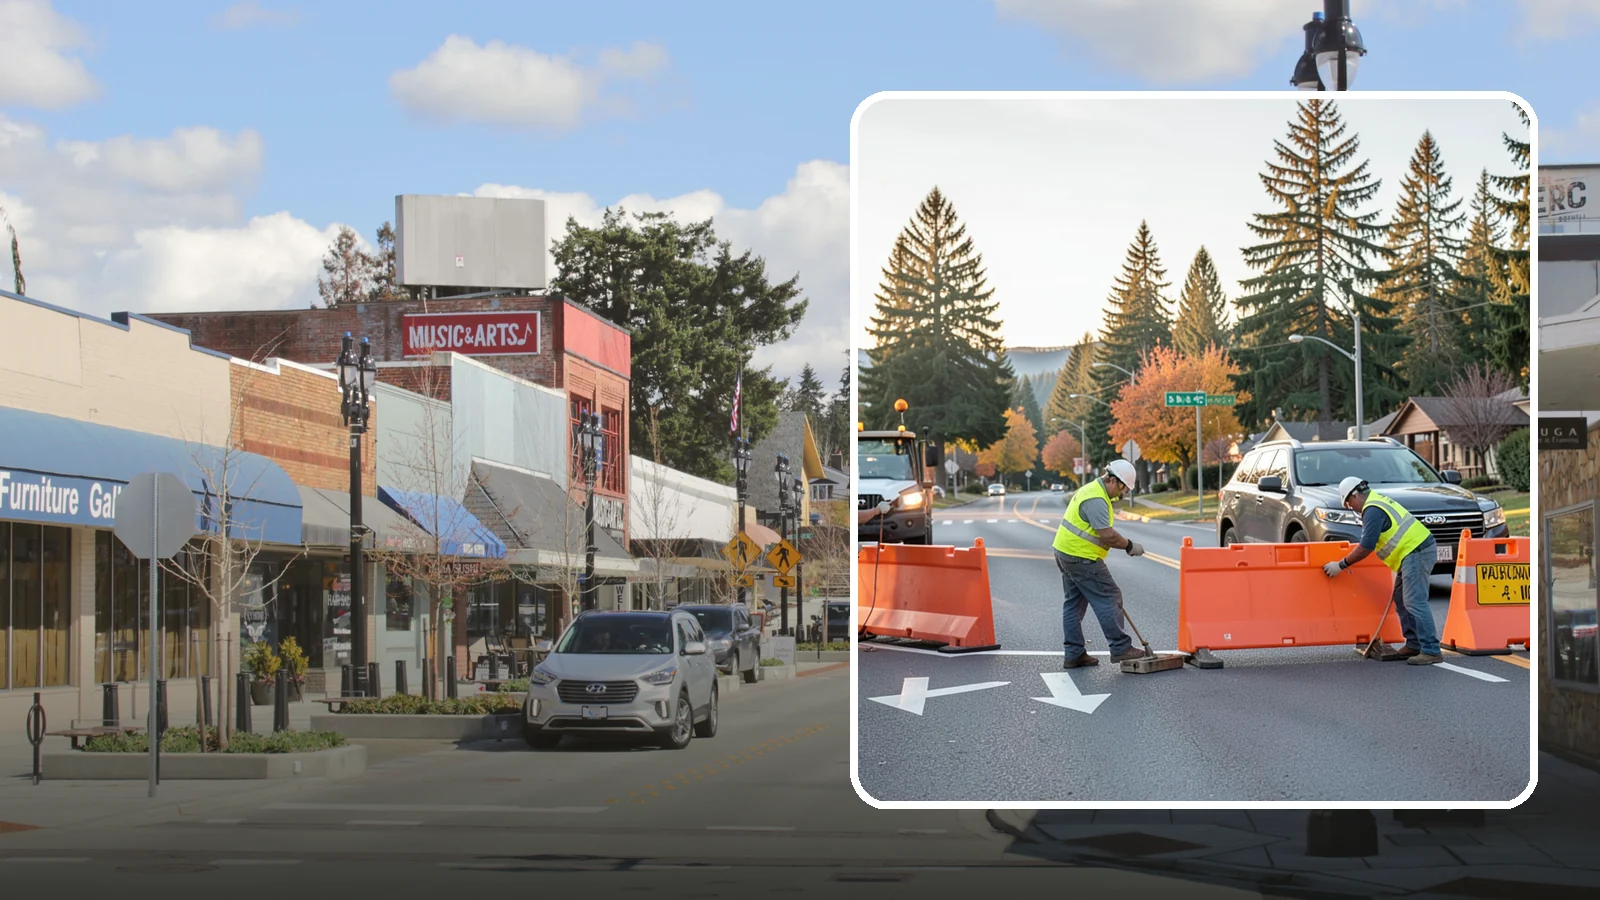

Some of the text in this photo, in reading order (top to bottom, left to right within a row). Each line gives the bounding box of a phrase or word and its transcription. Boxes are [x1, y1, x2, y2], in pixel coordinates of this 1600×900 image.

[409, 323, 520, 349] MUSIC&ARTS
[0, 472, 121, 519] Furniture Gal
